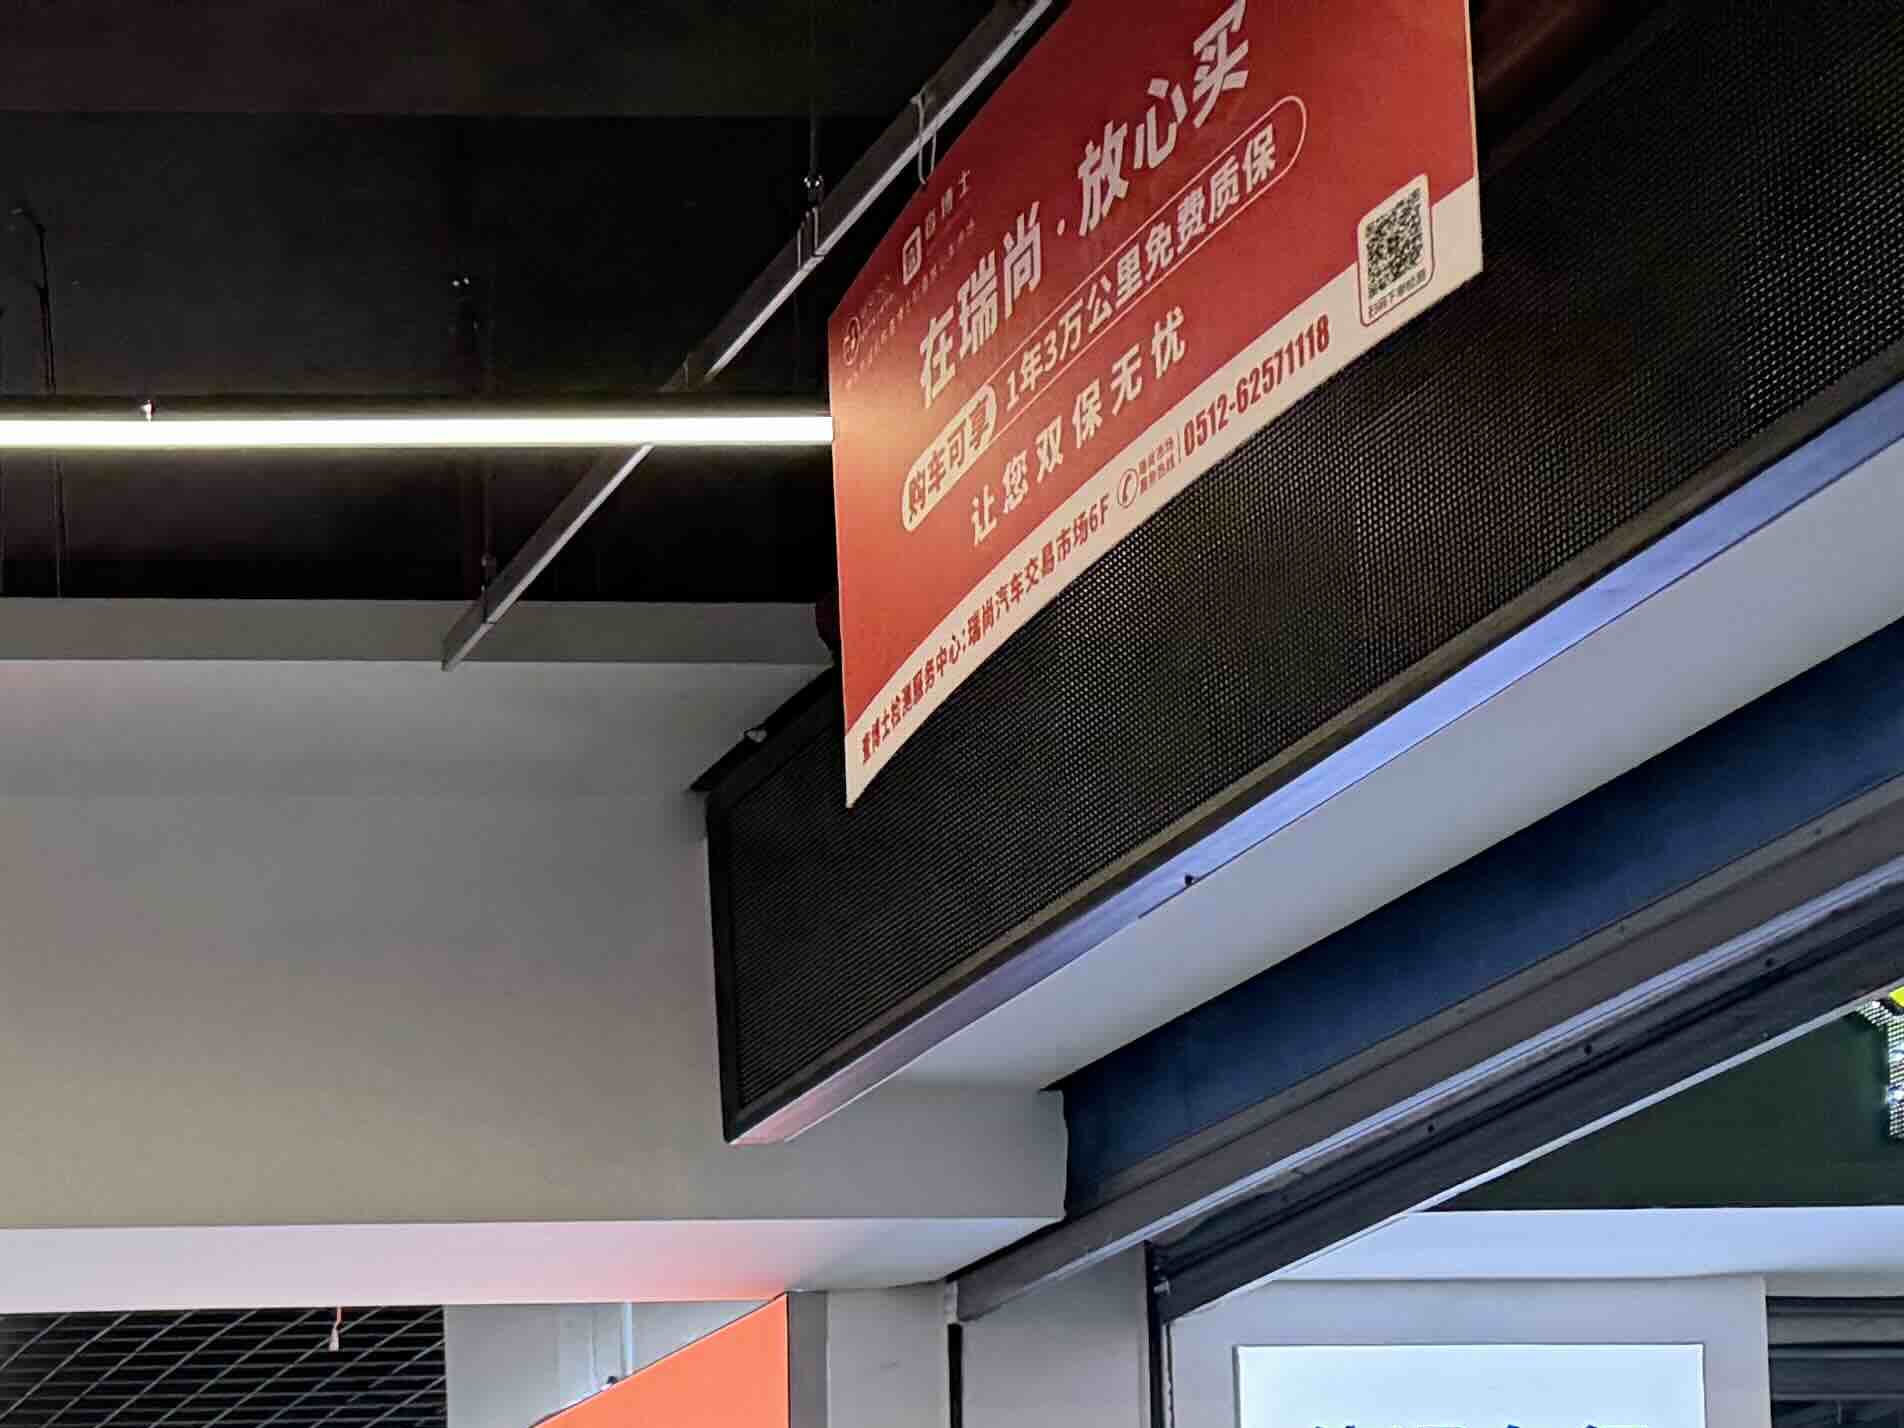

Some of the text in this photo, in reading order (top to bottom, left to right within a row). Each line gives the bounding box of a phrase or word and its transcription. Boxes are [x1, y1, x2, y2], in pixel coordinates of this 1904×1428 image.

[1006, 123, 1277, 411] 1年3万公里免费质保
[906, 389, 991, 523] 购车可享
[971, 305, 1186, 547] 让您双保无忧
[1183, 313, 1330, 457] 0512-62571118
